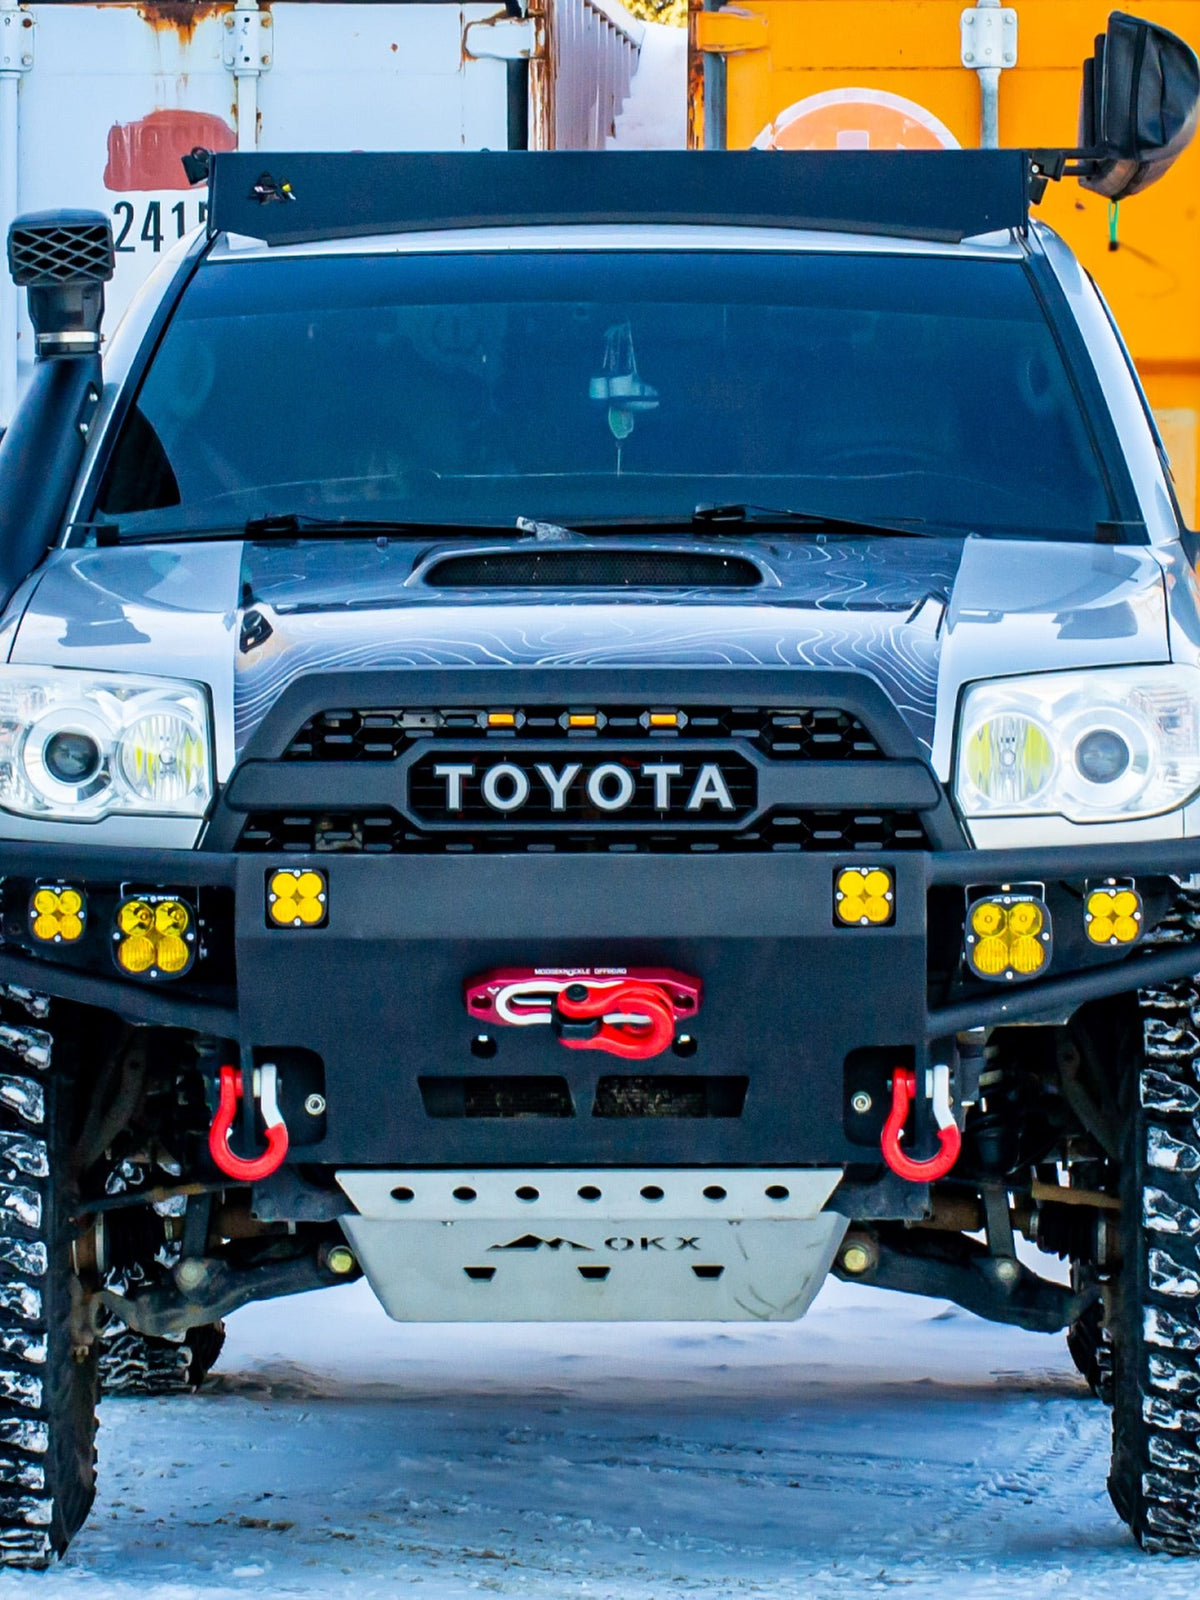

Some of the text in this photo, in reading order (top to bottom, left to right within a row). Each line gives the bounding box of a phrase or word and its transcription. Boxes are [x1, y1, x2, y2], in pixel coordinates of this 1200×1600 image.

[113, 200, 208, 252] 241
[433, 763, 736, 812] TOYOTA
[604, 1237, 701, 1251] OKX
